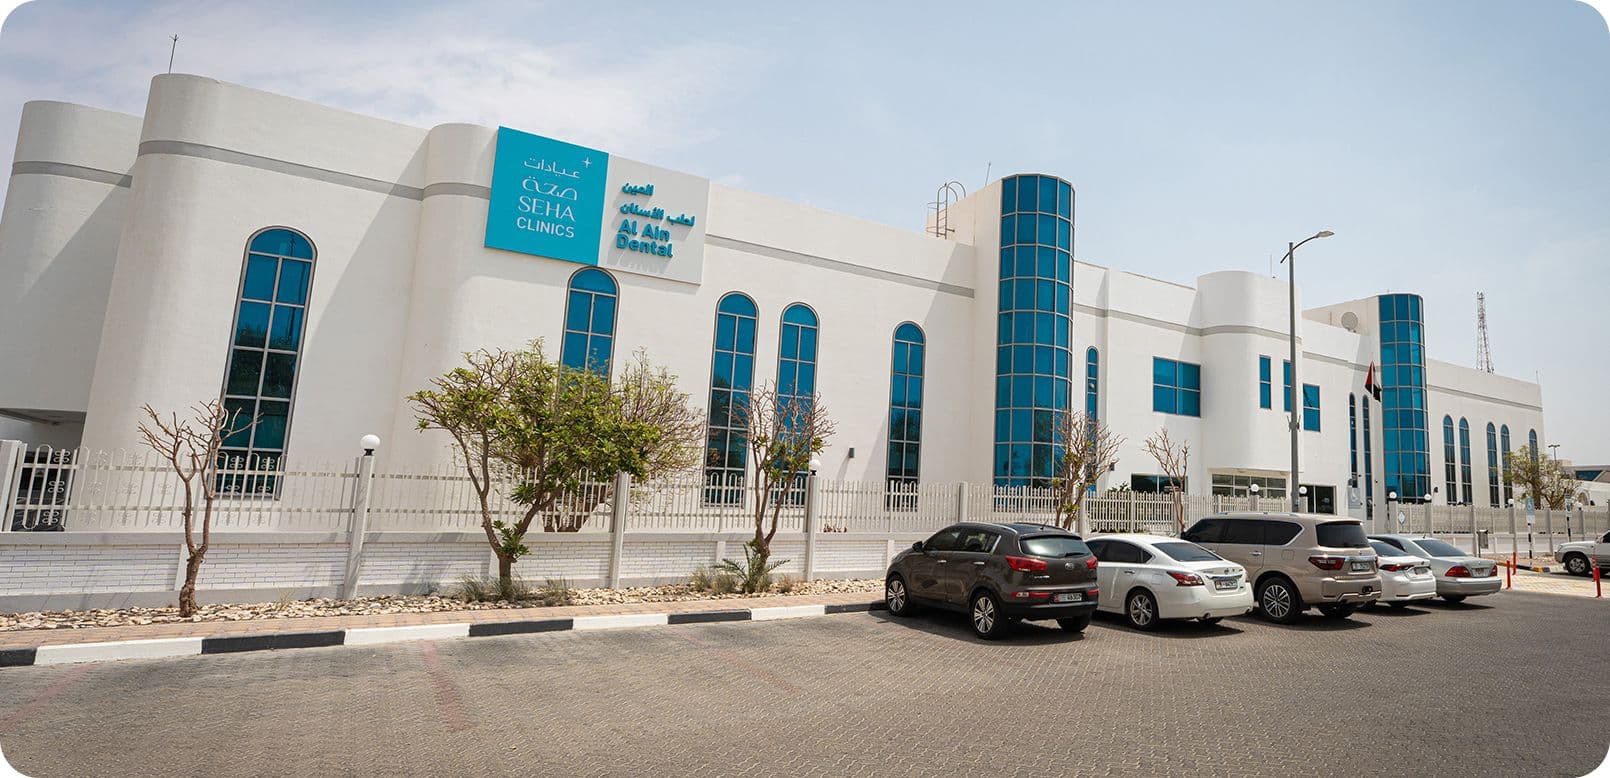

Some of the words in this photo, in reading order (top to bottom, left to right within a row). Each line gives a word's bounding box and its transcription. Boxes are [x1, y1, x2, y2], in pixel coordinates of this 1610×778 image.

[524, 157, 580, 179] عيادات
[522, 176, 577, 200] صحة
[622, 182, 654, 196] العين
[518, 195, 576, 222] SEHA
[620, 203, 664, 220] الأسنان
[516, 217, 574, 238] CLINICS
[618, 219, 637, 236] Al
[642, 223, 670, 241] Ain
[667, 214, 695, 227] لطب
[616, 234, 673, 257] Dental
